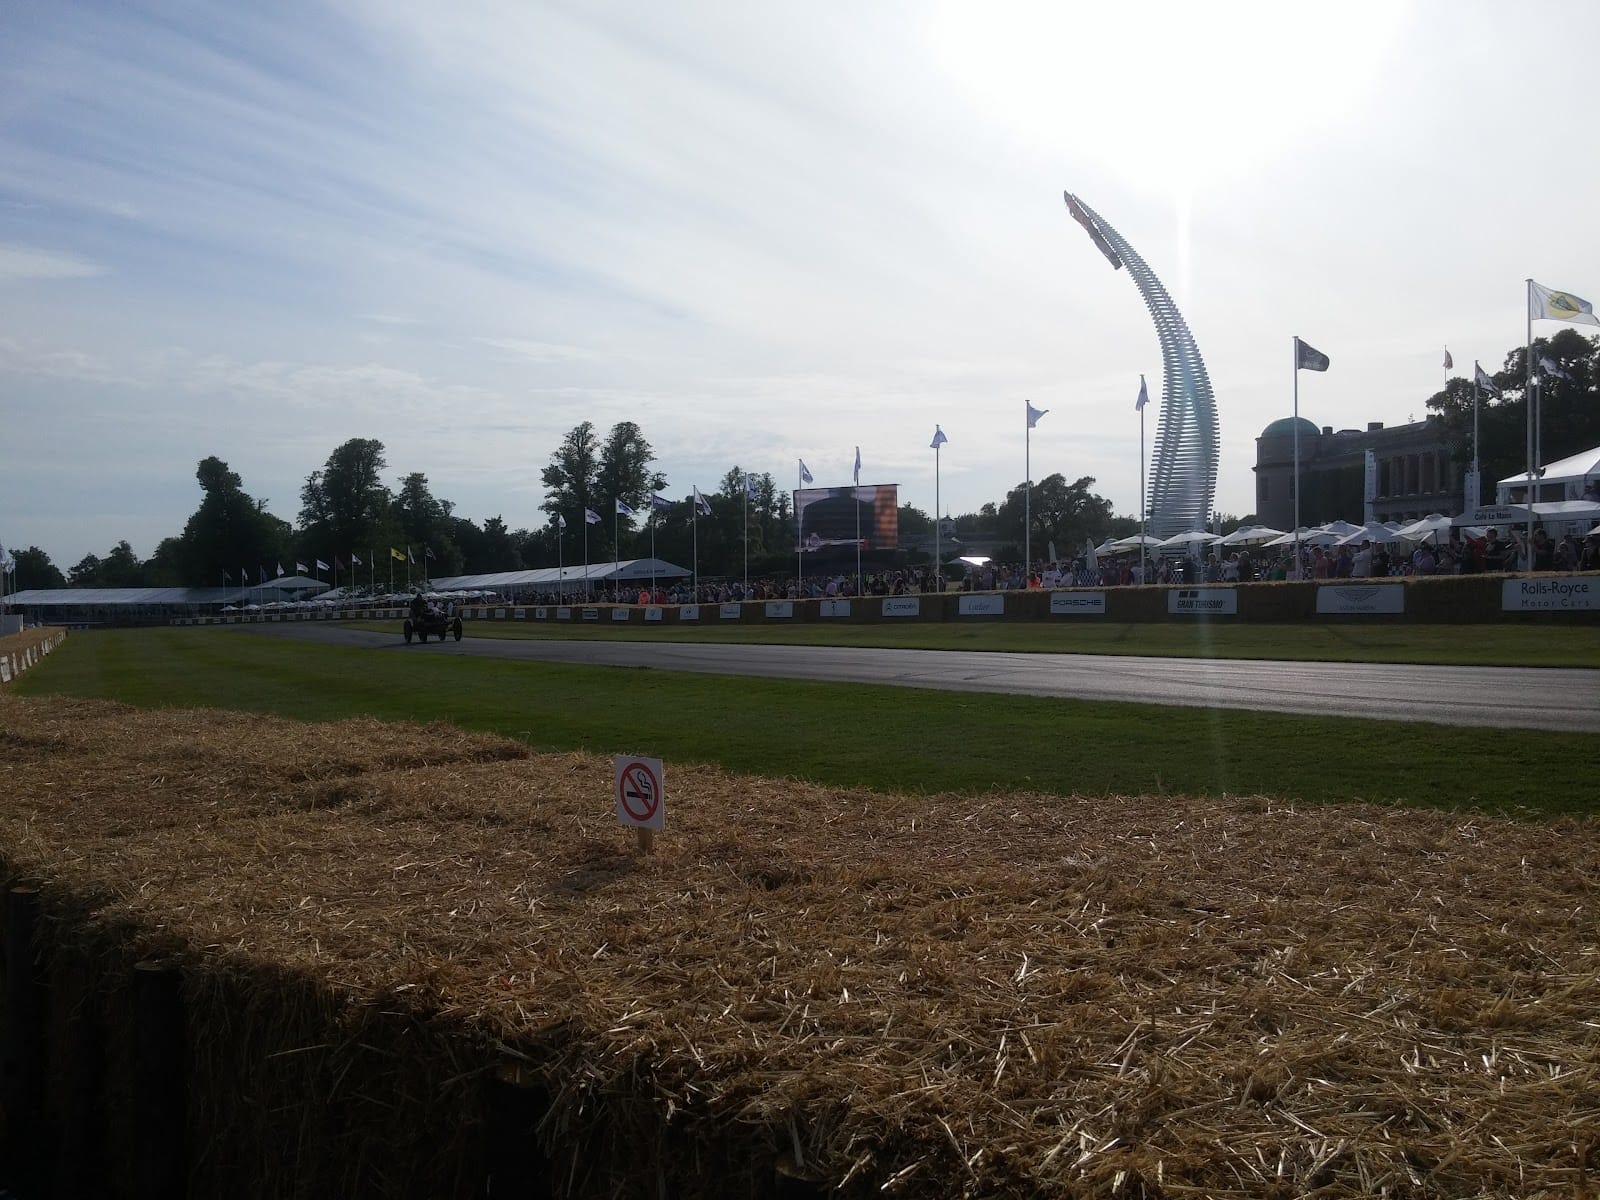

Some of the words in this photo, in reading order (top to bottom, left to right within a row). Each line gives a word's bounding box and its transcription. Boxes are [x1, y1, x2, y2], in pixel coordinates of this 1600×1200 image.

[1521, 581, 1589, 597] Rolls-Royce
[1177, 600, 1193, 609] GRAN
[1521, 599, 1554, 607] Motor
[1560, 598, 1589, 607] Cars
